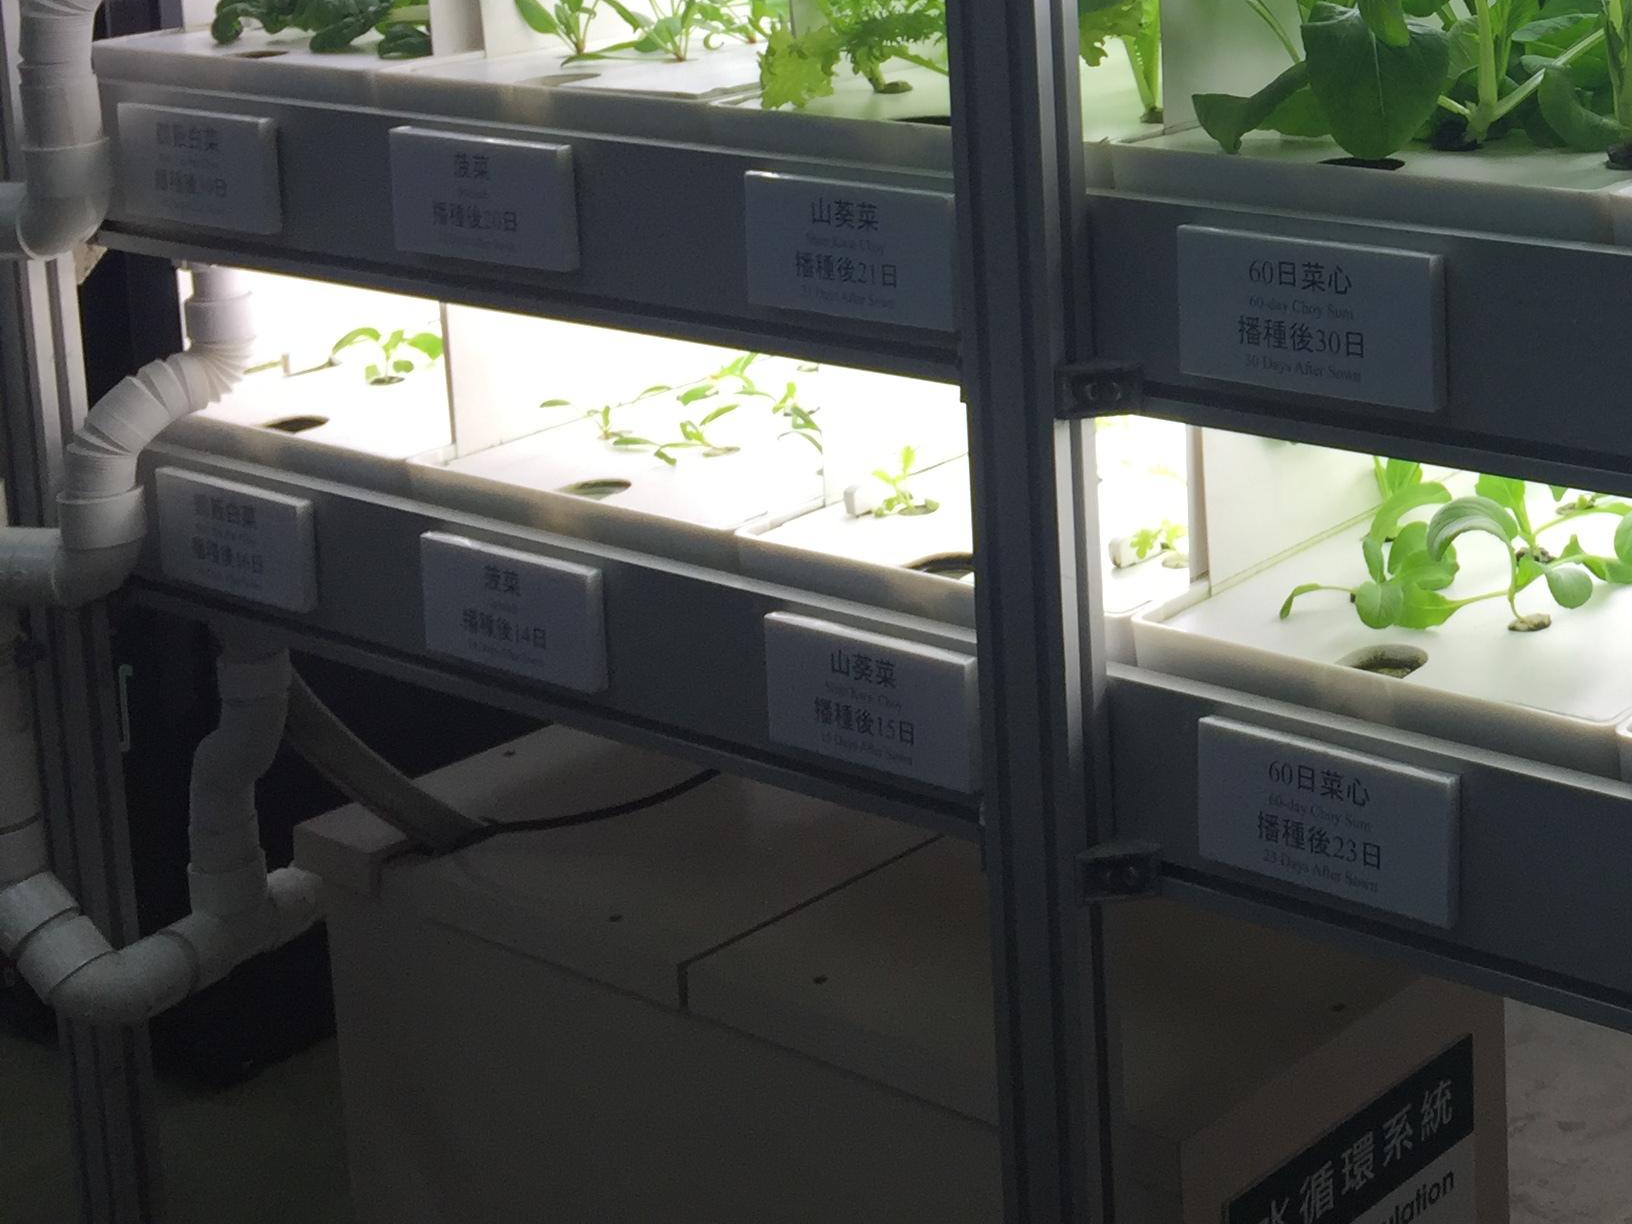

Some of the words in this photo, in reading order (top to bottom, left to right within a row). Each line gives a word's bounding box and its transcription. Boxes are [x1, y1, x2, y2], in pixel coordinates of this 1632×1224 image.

[810, 196, 880, 233] 山葵菜
[794, 249, 899, 289] 播種後21日
[1247, 259, 1353, 296] 60日菜心
[1237, 314, 1366, 360] 播種後30日
[830, 649, 897, 690] 山葵菜
[1267, 759, 1371, 808] 60日菜心
[1257, 810, 1382, 871] 播種後23日
